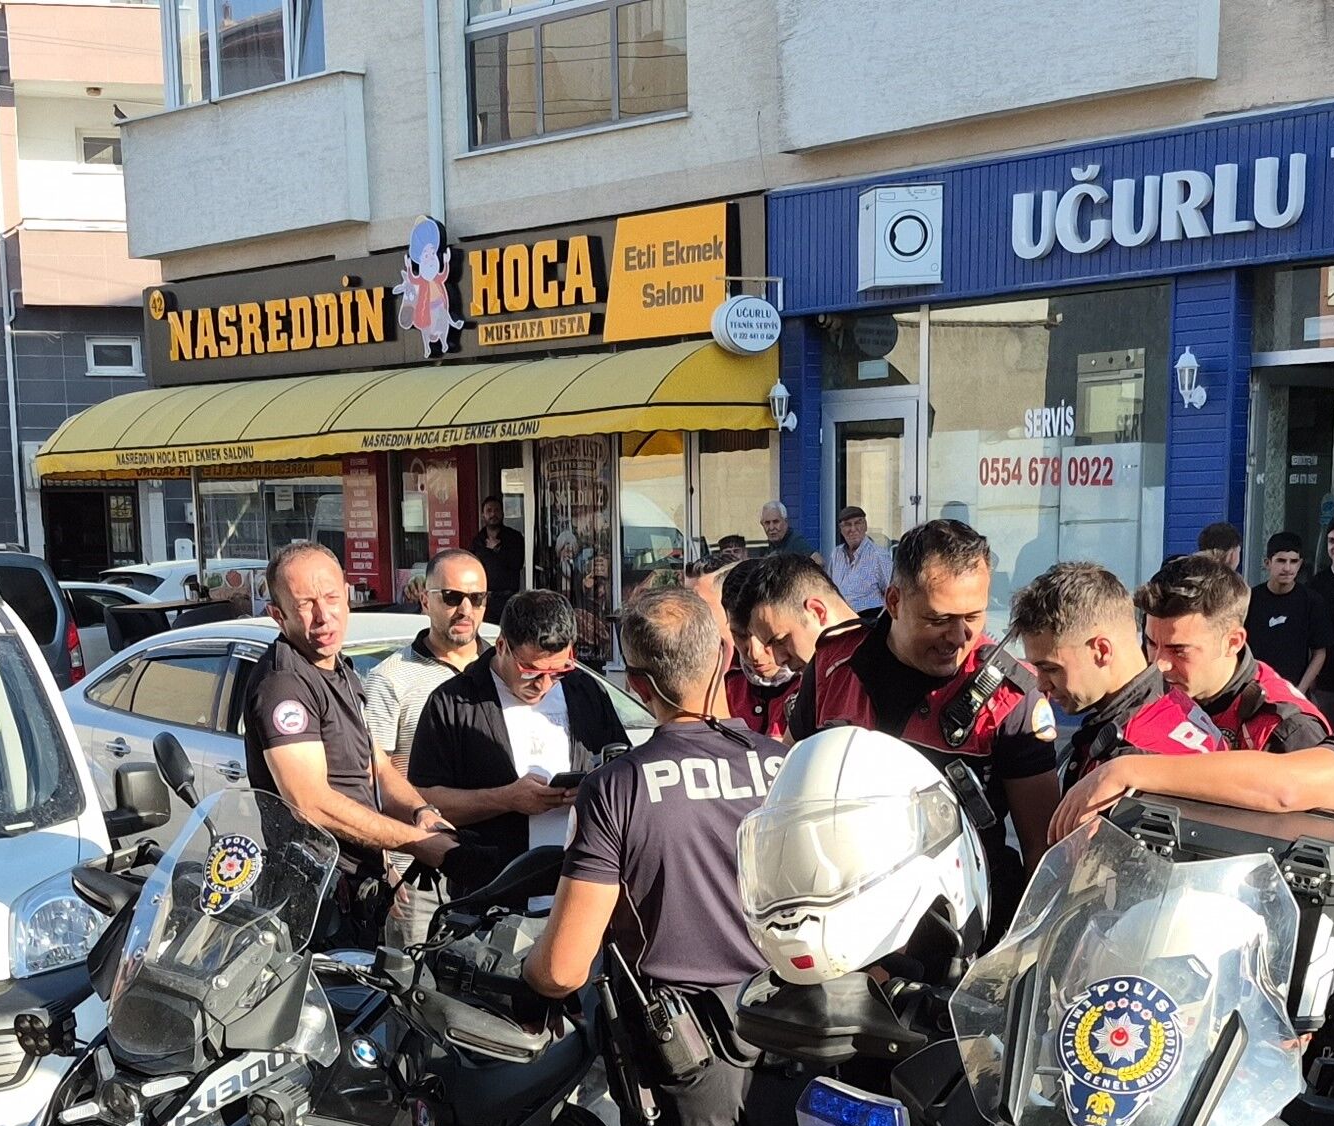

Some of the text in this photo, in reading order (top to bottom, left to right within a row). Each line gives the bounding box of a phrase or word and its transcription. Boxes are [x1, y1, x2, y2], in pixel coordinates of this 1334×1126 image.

[1012, 153, 1307, 260] UĞURLU
[623, 234, 725, 272] Etli Ekmek
[151, 296, 165, 313] 42
[167, 234, 596, 362] NASREDDİN HOCA
[641, 282, 705, 309] Salonu
[736, 306, 772, 319] UĞURLU
[483, 315, 586, 343] MUSTAFA USTA
[1023, 398, 1076, 439] SERVİS
[414, 430, 440, 446] HOCA
[464, 424, 498, 441] EKMEK
[499, 420, 541, 438] SALONU
[156, 449, 177, 465] HOCA
[195, 447, 222, 462] EKMEK
[223, 445, 255, 460] SALONU
[979, 455, 1114, 487] 0554 678 0922
[1083, 1071, 1130, 1091] GENEL
